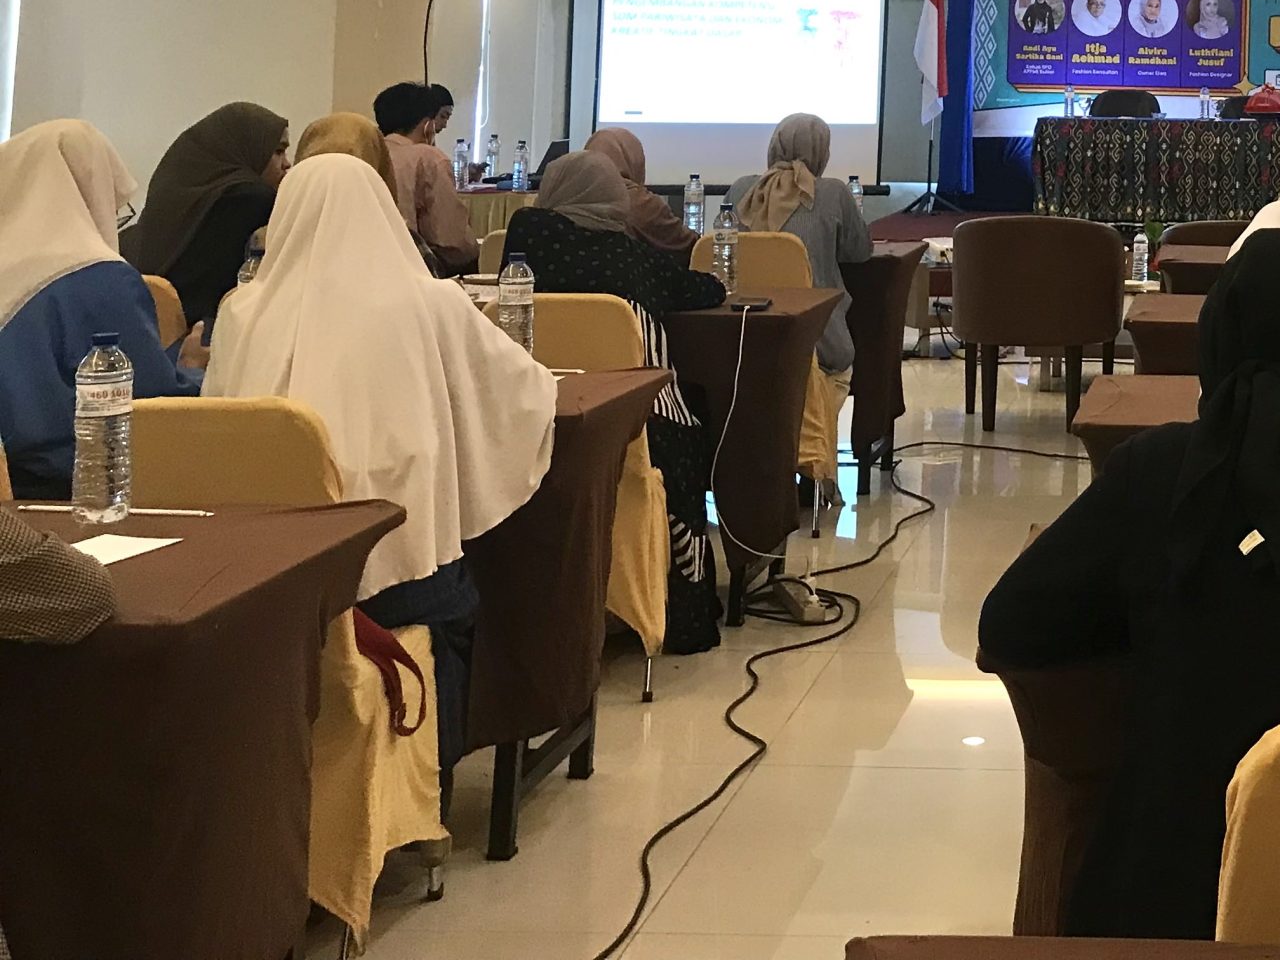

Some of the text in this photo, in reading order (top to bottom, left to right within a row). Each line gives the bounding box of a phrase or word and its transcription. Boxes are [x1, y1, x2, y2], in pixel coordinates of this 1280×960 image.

[1189, 48, 1234, 57] Luthfiani
[1128, 56, 1177, 65] Ramdhani
[1197, 57, 1225, 66] Jusuf
